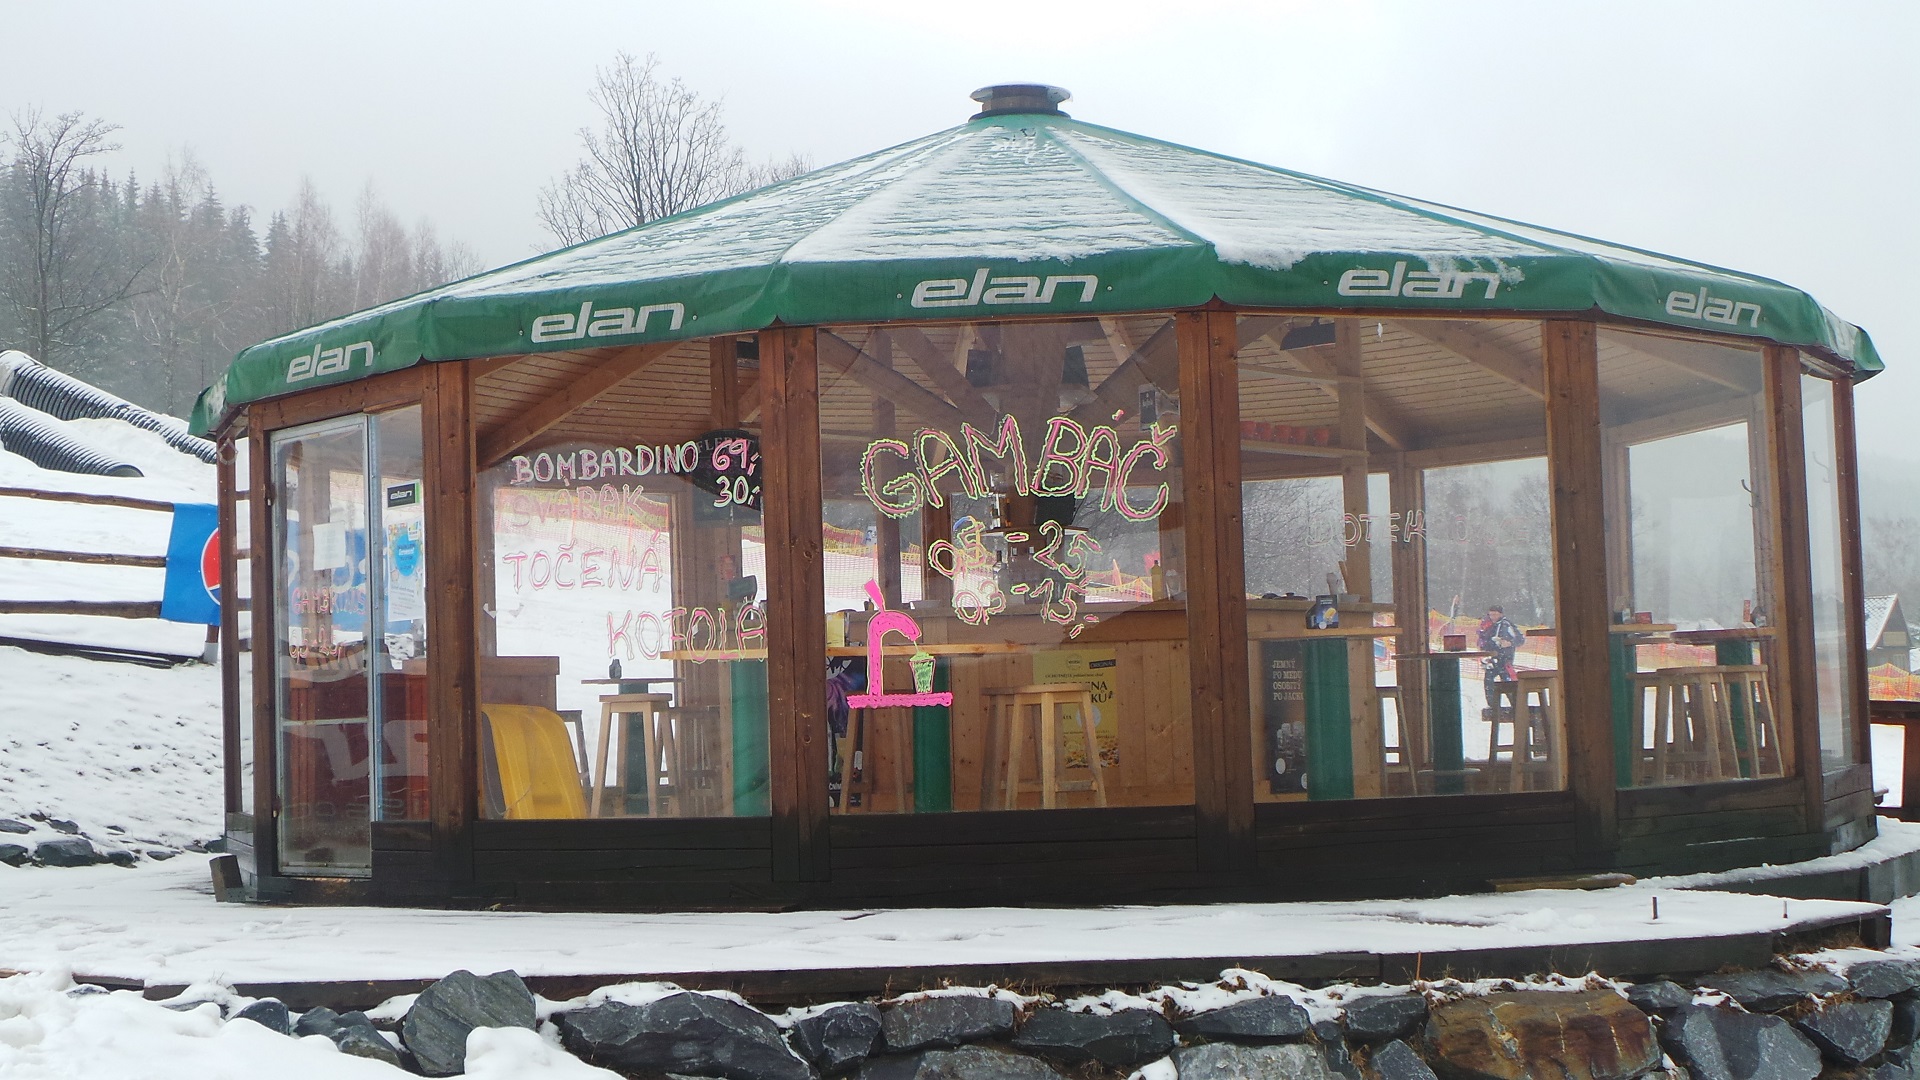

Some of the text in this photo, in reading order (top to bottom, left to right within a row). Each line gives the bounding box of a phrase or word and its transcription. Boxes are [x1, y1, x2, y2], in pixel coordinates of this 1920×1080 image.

[910, 267, 1098, 308] elan
[1337, 261, 1501, 299] elan
[531, 301, 685, 343] elan
[1665, 286, 1762, 328] elan
[286, 340, 373, 383] elan
[510, 440, 699, 485] BOMBARDINO
[390, 489, 413, 500] elan
[503, 529, 663, 594] TOČENÁ
[1273, 671, 1282, 680] PO
